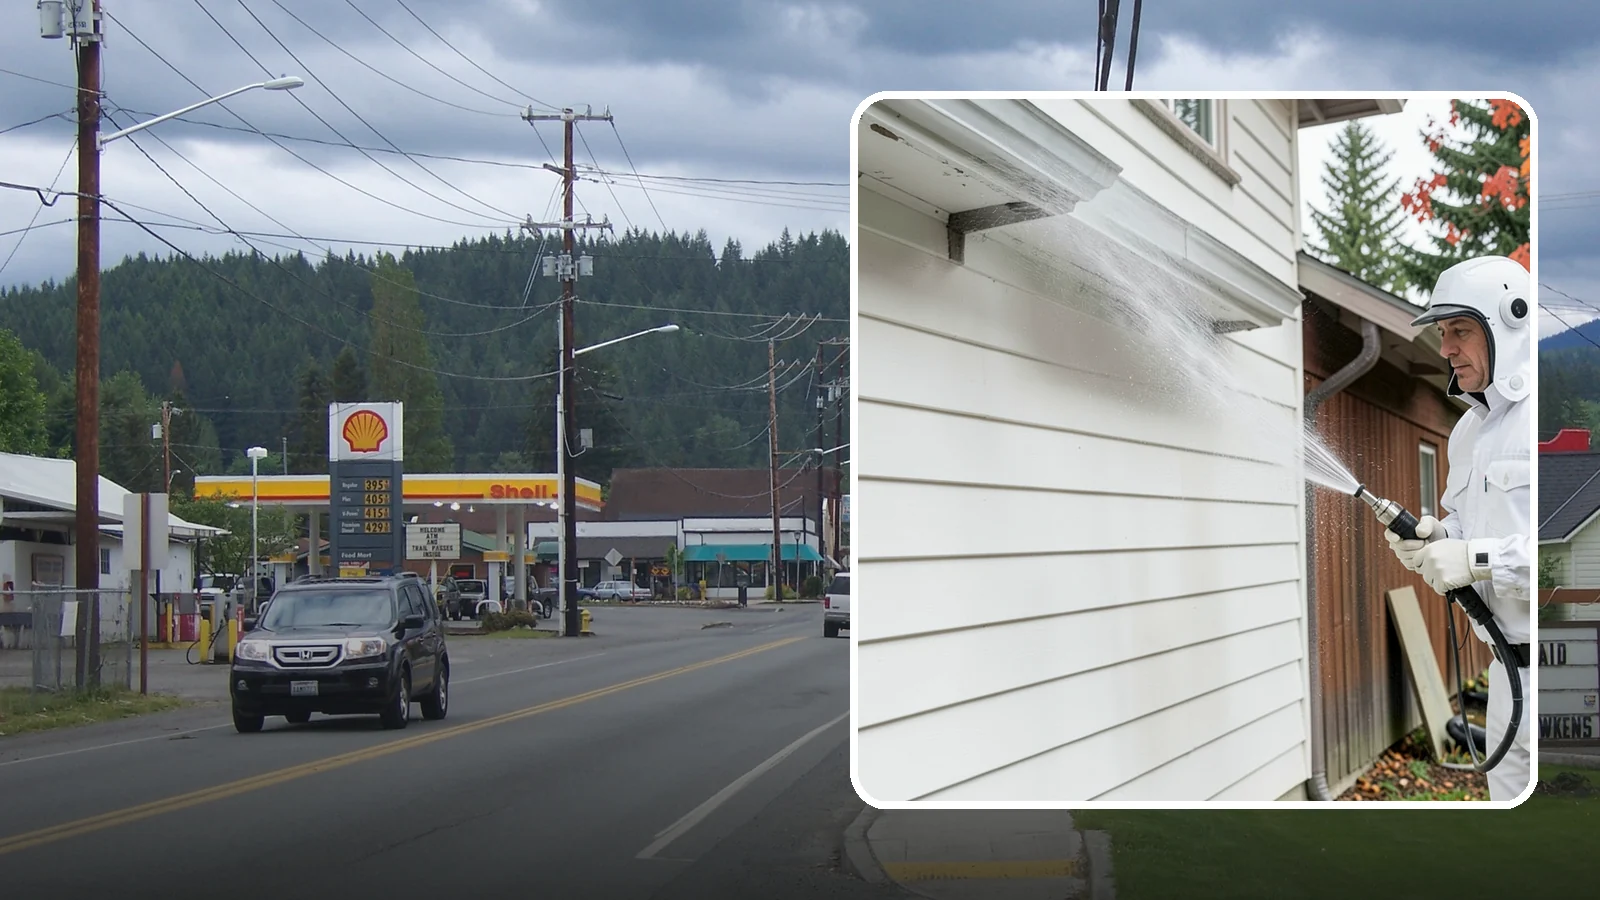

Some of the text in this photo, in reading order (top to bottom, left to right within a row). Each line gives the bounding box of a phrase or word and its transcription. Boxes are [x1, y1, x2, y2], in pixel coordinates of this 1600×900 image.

[365, 480, 383, 490] 395
[490, 484, 547, 499] Shell
[365, 494, 383, 504] 405
[365, 508, 383, 518] 415
[365, 522, 383, 532] 429
